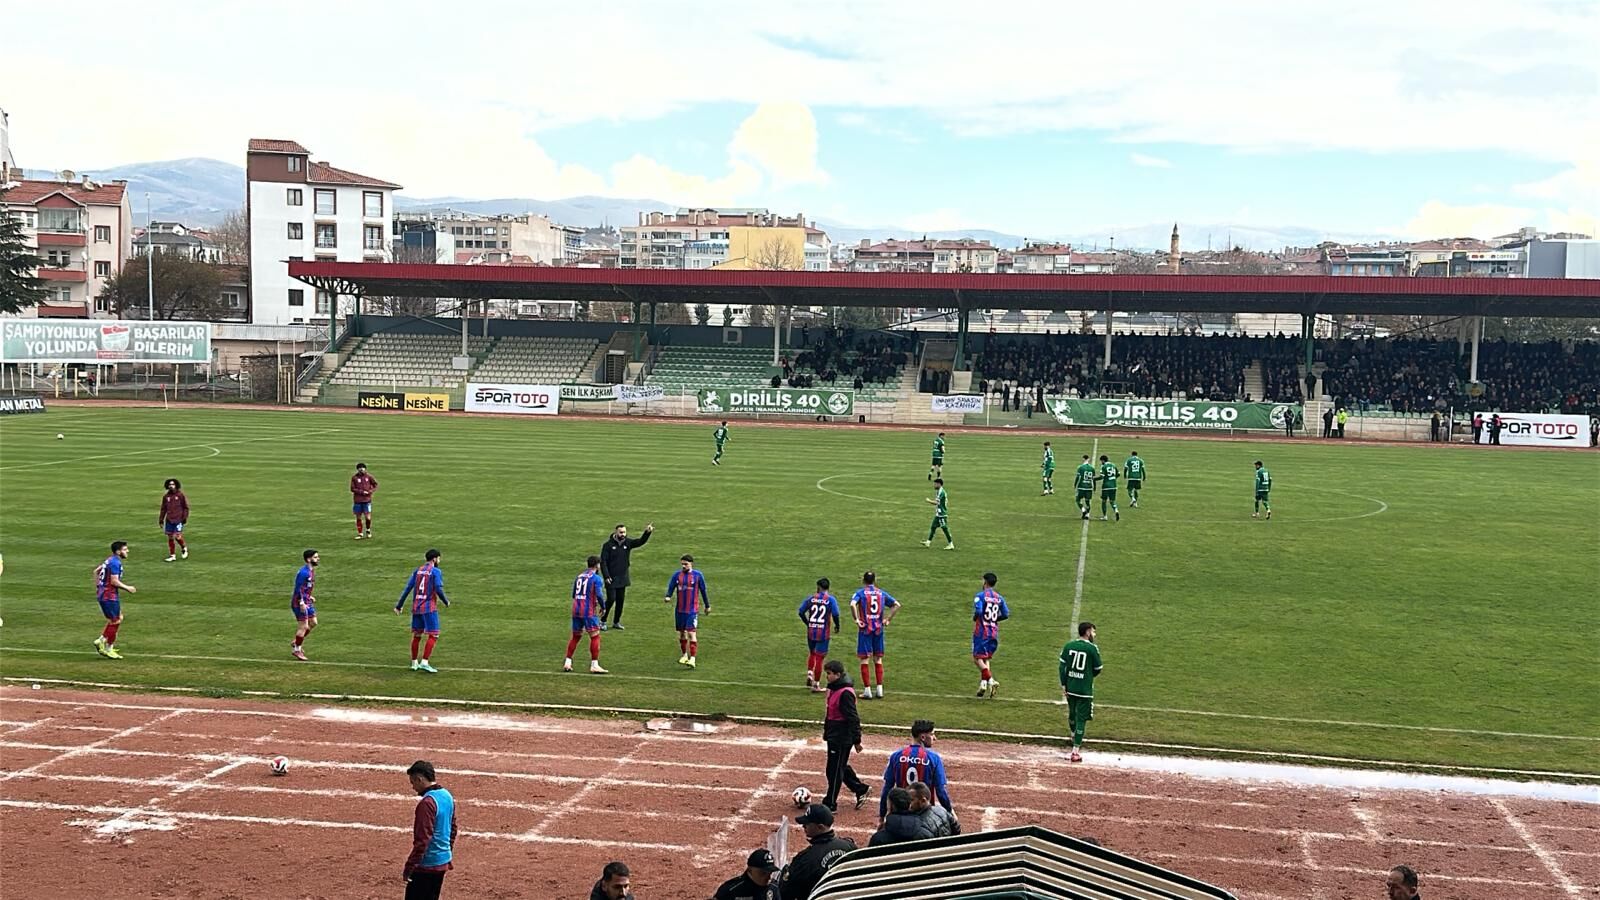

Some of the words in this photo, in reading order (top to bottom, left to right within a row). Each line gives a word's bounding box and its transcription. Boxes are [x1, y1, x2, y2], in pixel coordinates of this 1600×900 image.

[5, 323, 97, 341] ŞAMPİYONLUK
[133, 327, 205, 341] BAŞARILAR
[25, 340, 98, 355] YOLUNDA
[134, 341, 194, 357] DİLERİM
[562, 387, 576, 396] SEN
[730, 390, 792, 410] DİRİLİŞ
[797, 394, 820, 407] 40
[14, 399, 44, 410] METAL
[1106, 401, 1196, 422] DİRİLİŞ
[1202, 406, 1238, 421] 40
[419, 575, 426, 594] 4
[575, 578, 589, 595] 91
[870, 596, 878, 613] 5
[984, 603, 999, 621] 58
[809, 604, 826, 623] 22
[1068, 650, 1087, 670] 70
